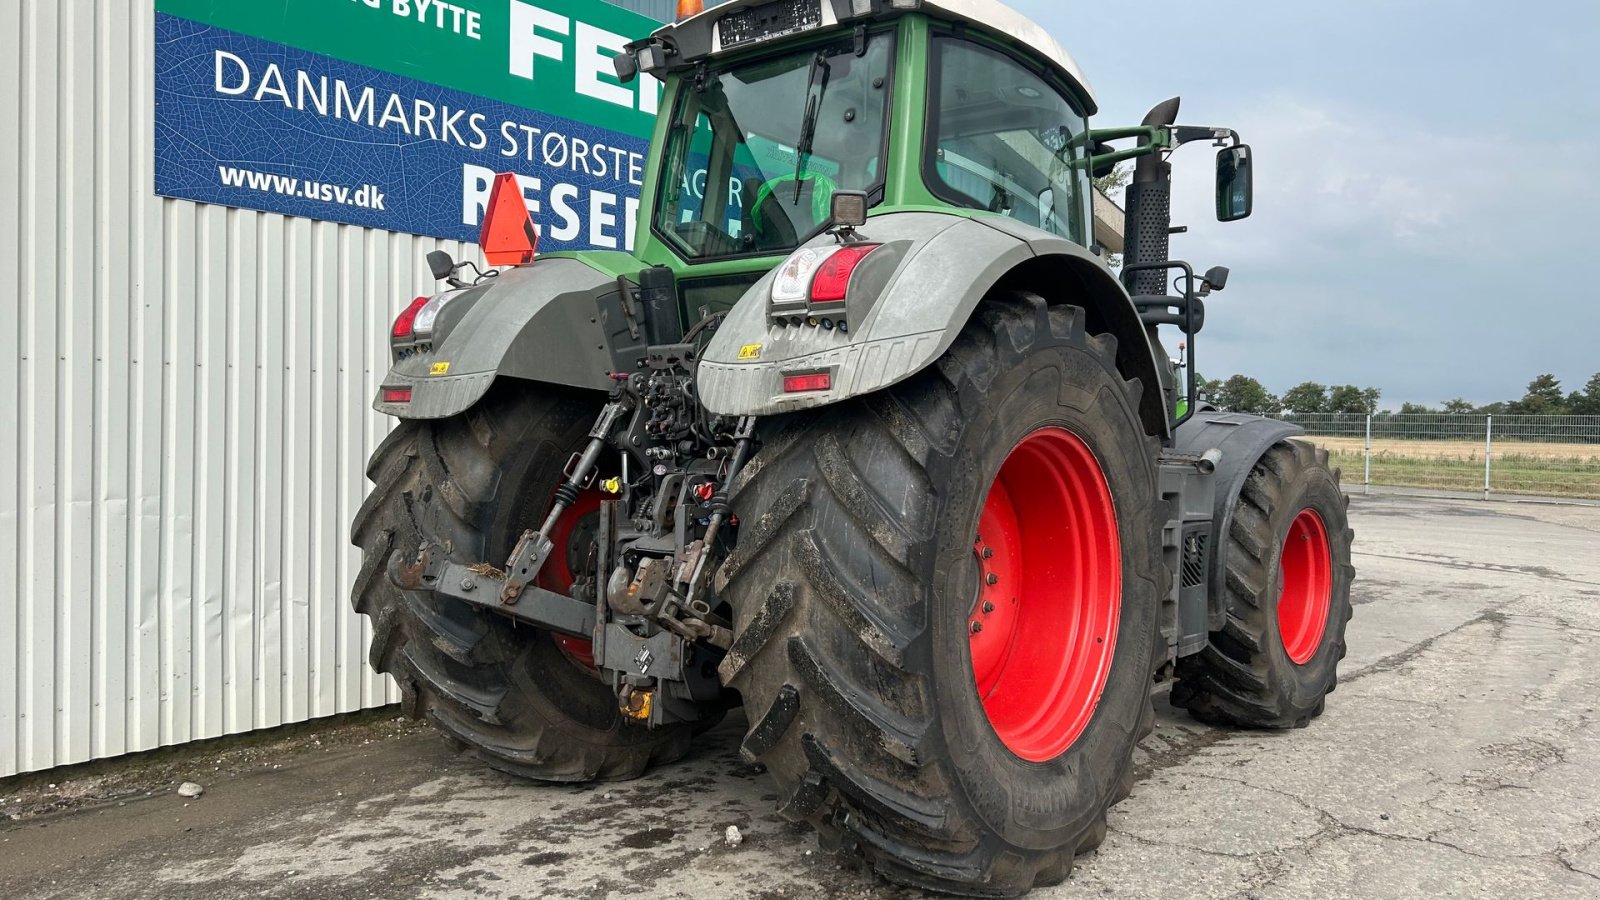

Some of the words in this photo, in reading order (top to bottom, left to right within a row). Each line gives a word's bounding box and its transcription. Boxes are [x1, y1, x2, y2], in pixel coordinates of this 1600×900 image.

[393, 0, 481, 40] BYTTE
[214, 50, 487, 150] DANMARKS
[501, 121, 643, 186] STØRSTE
[219, 166, 385, 210] www.usv.dk
